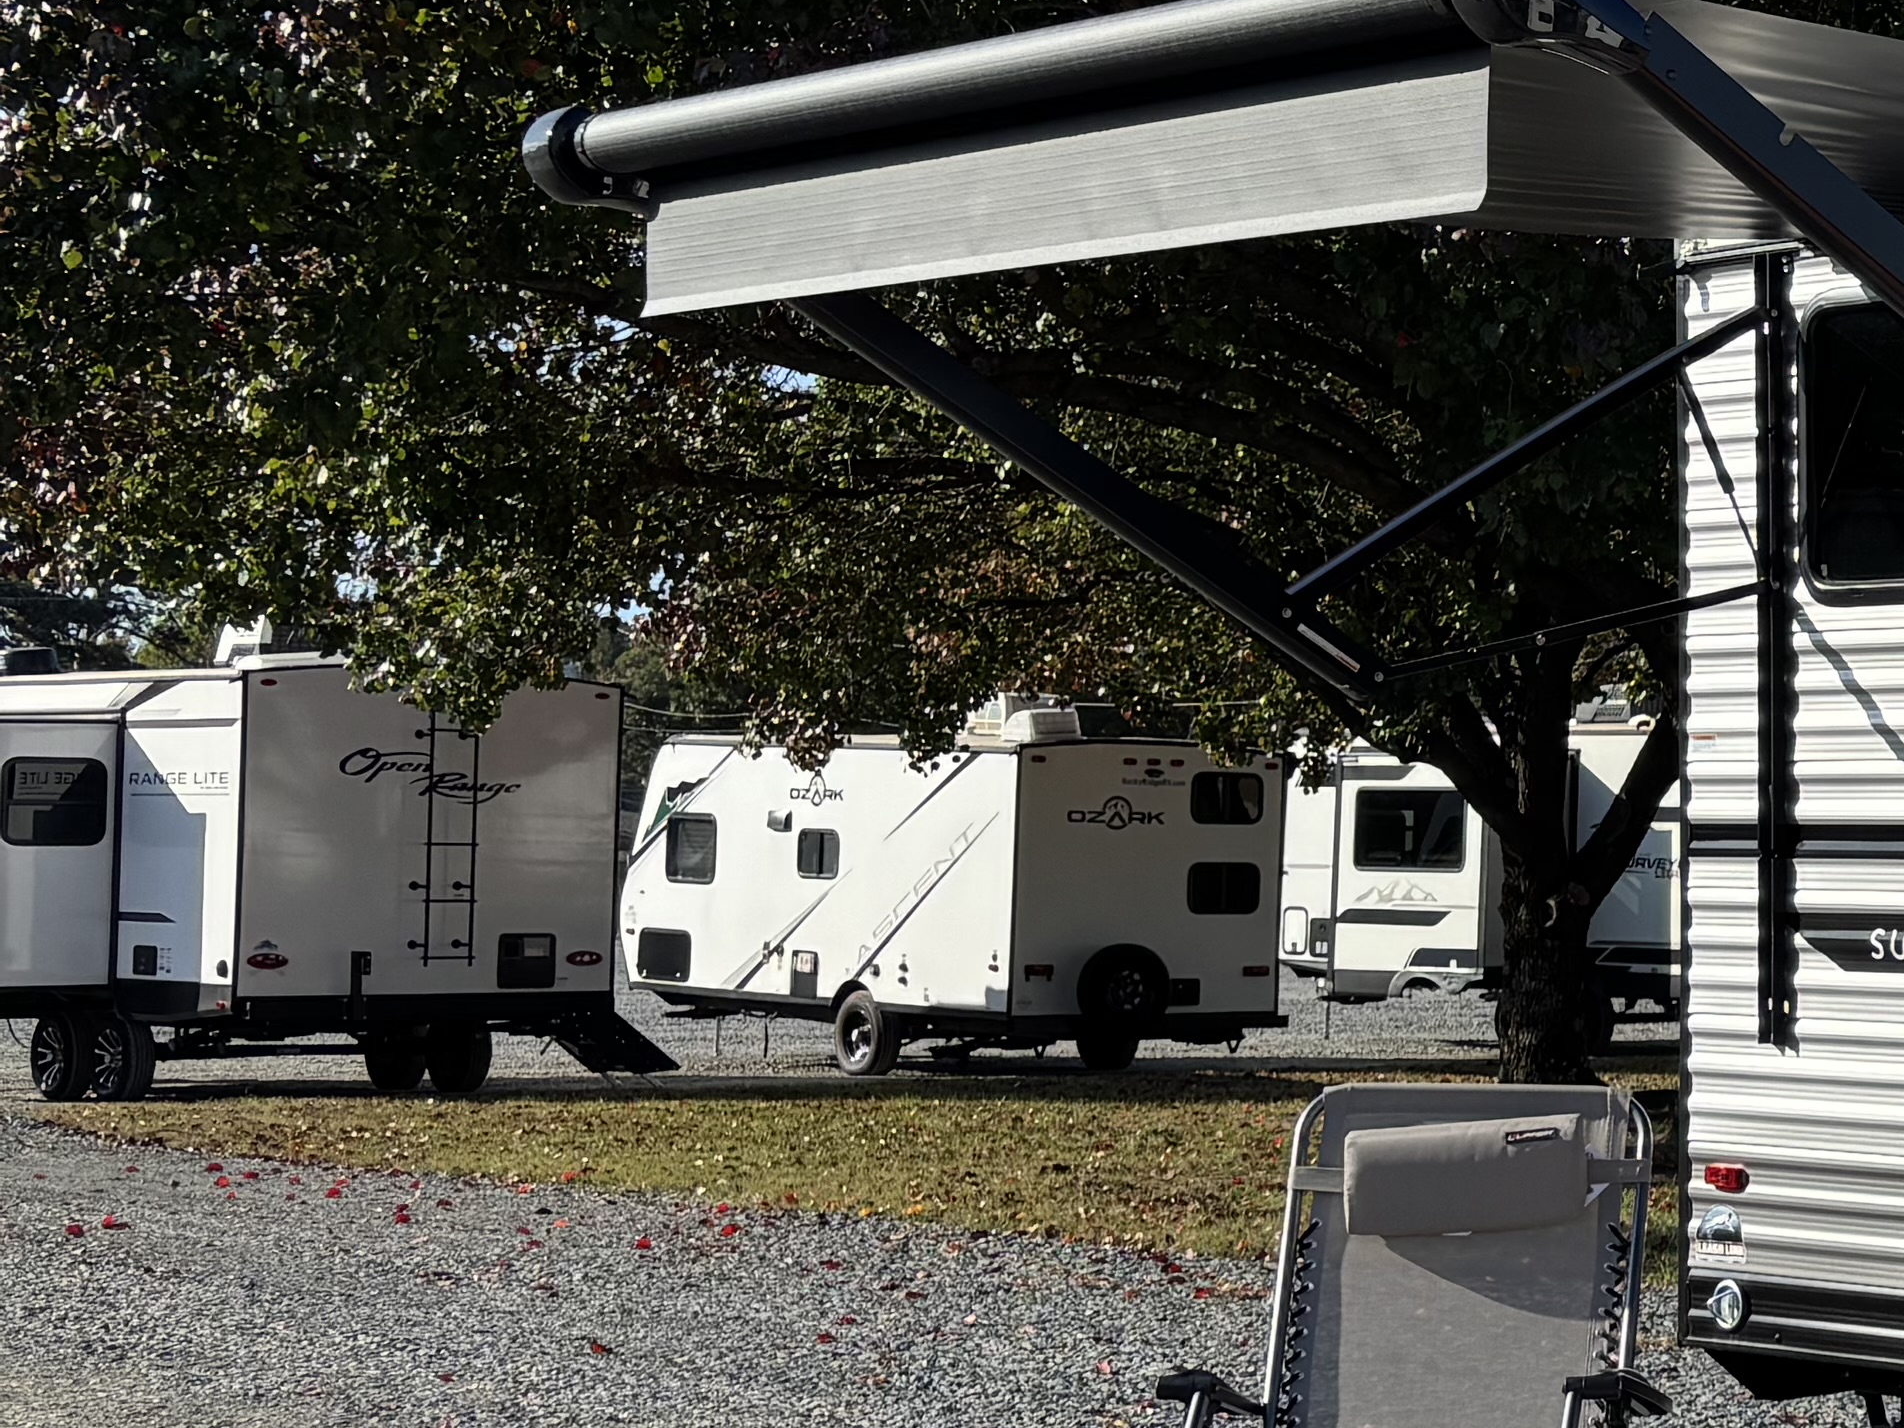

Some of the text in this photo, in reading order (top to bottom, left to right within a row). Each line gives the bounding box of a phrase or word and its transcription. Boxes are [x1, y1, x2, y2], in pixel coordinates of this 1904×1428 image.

[129, 772, 230, 785] RANGE LITE
[339, 747, 433, 783] Open
[409, 772, 521, 805] Range
[790, 786, 844, 806] OZARK
[1067, 809, 1166, 830] OZARK
[856, 820, 976, 966] ASCENT
